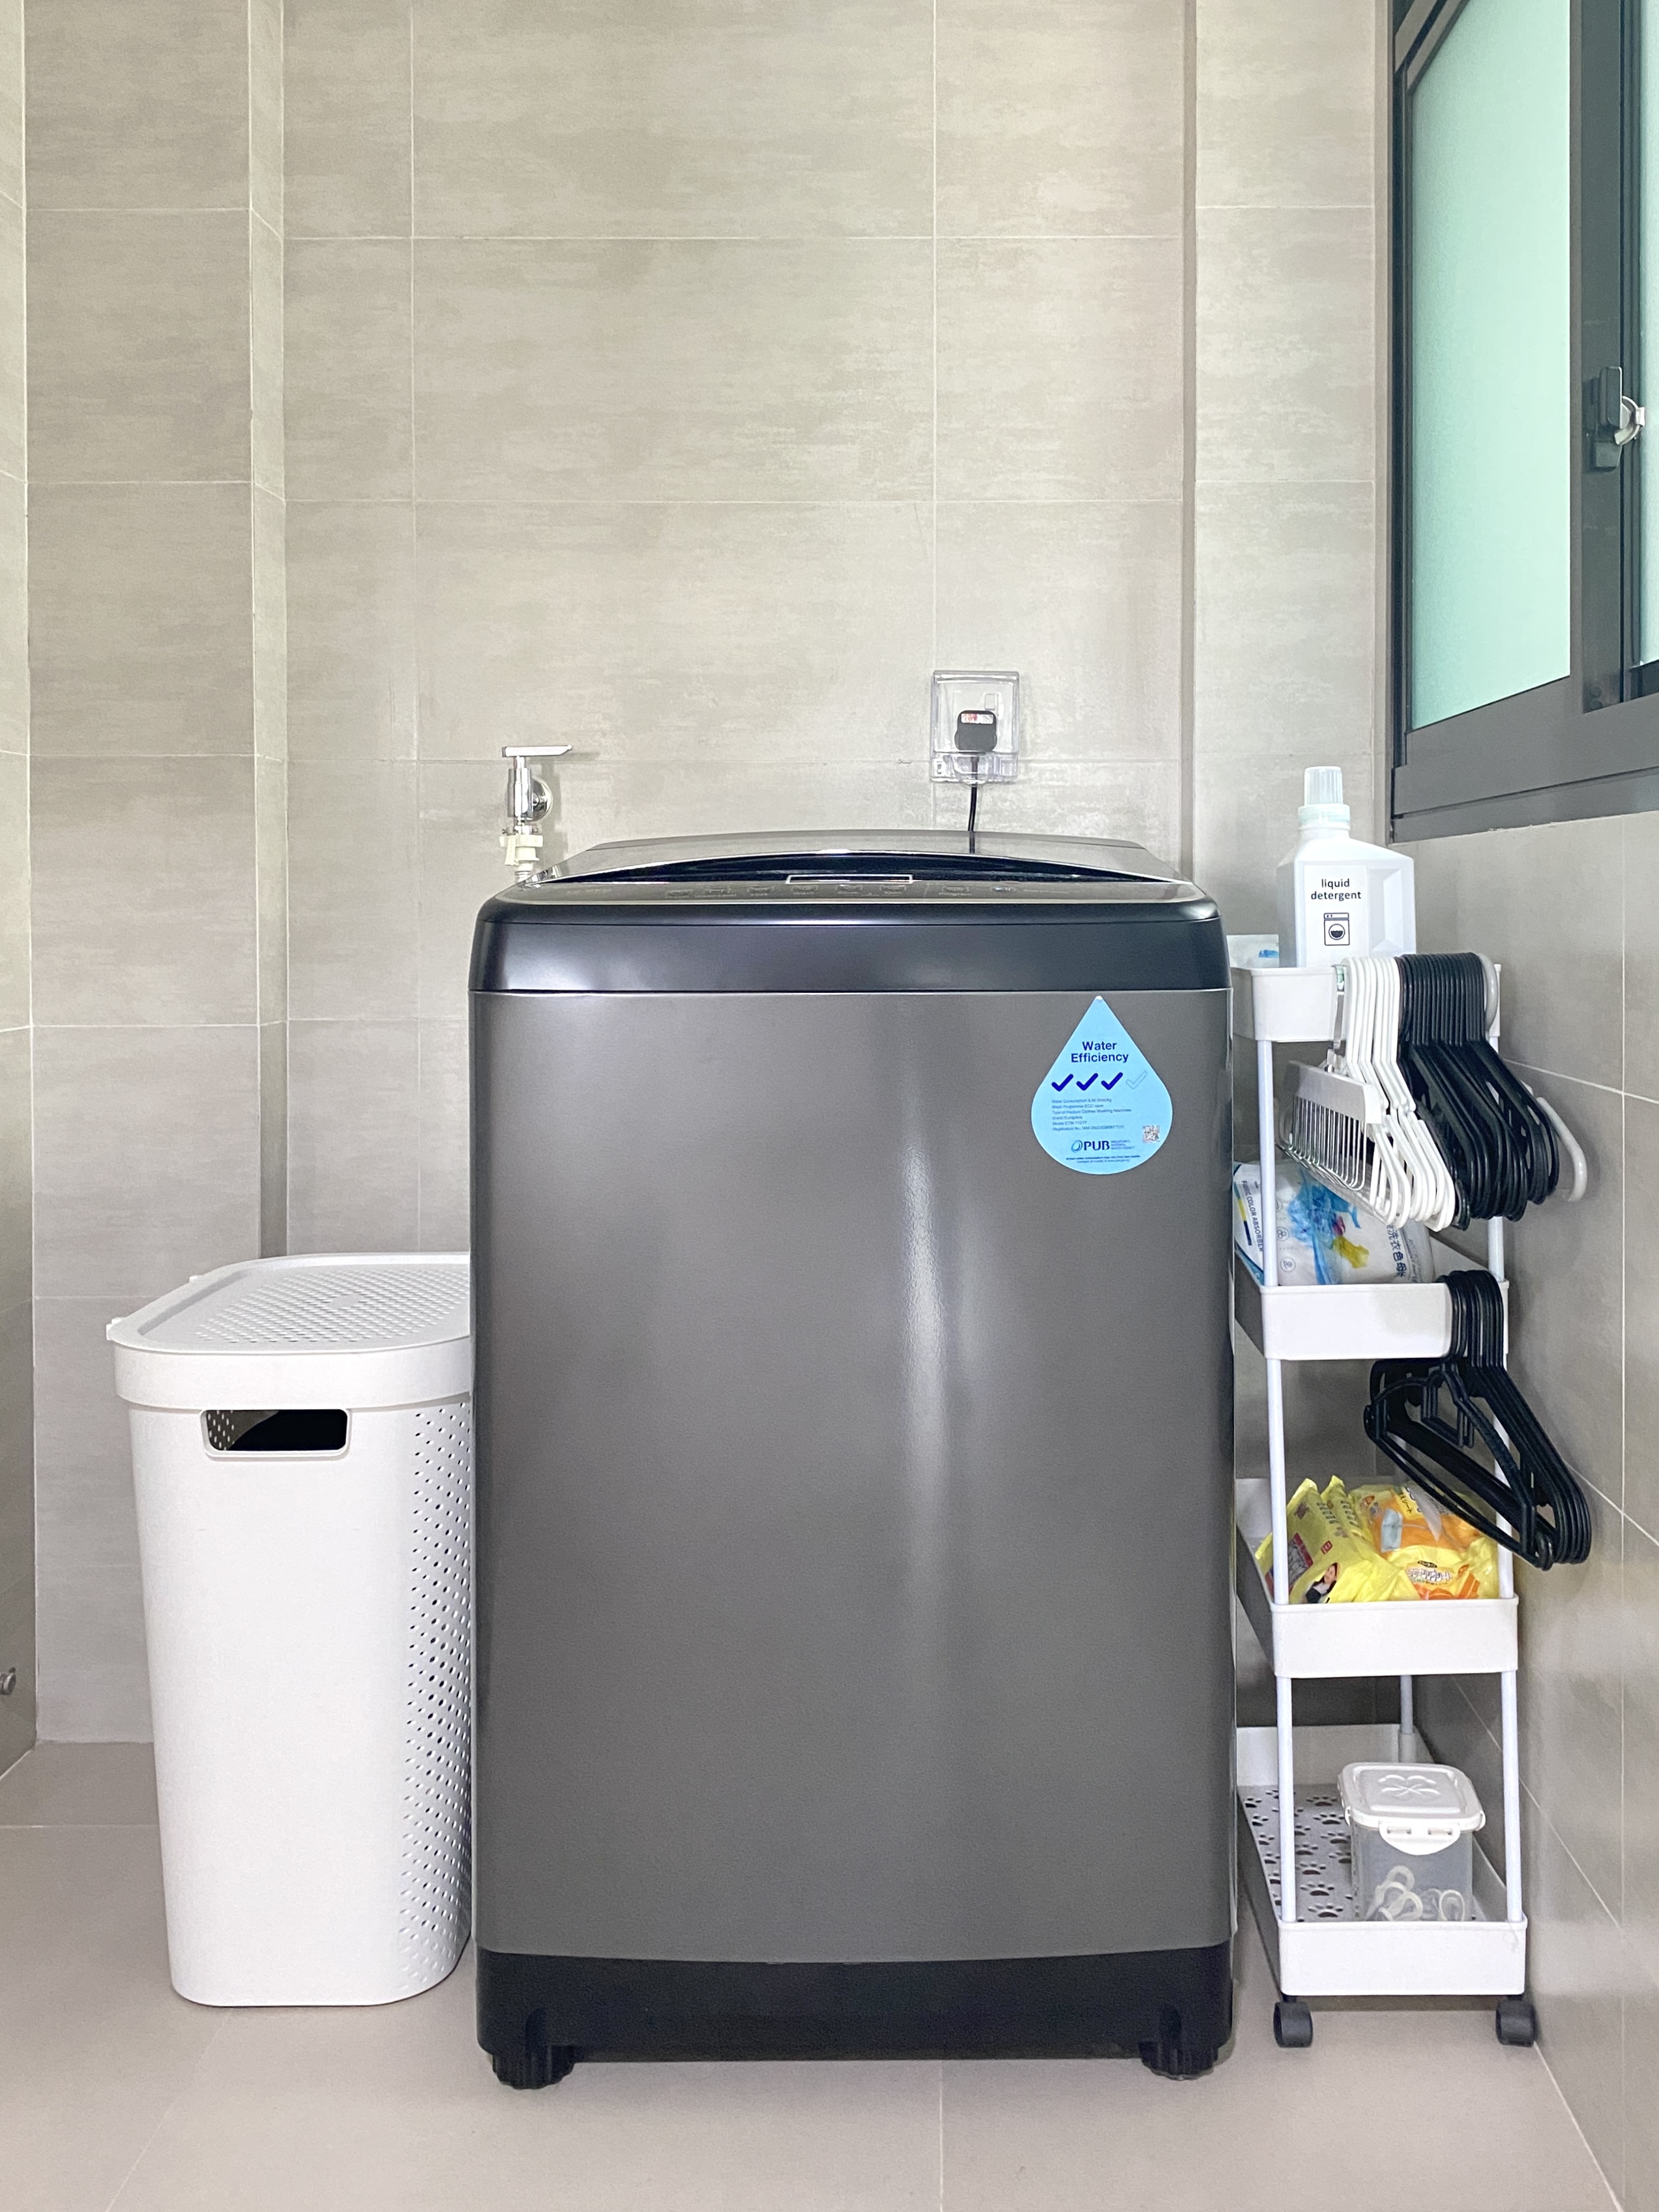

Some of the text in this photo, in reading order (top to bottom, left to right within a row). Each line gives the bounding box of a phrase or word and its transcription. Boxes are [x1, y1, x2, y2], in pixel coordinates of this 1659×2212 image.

[1321, 879, 1350, 890] liquid
[1311, 891, 1362, 902] detergent
[1082, 1040, 1117, 1051] Water
[1071, 1052, 1129, 1064] Efficiency
[1083, 1140, 1110, 1151] PUB
[1246, 1196, 1257, 1217] COLOR
